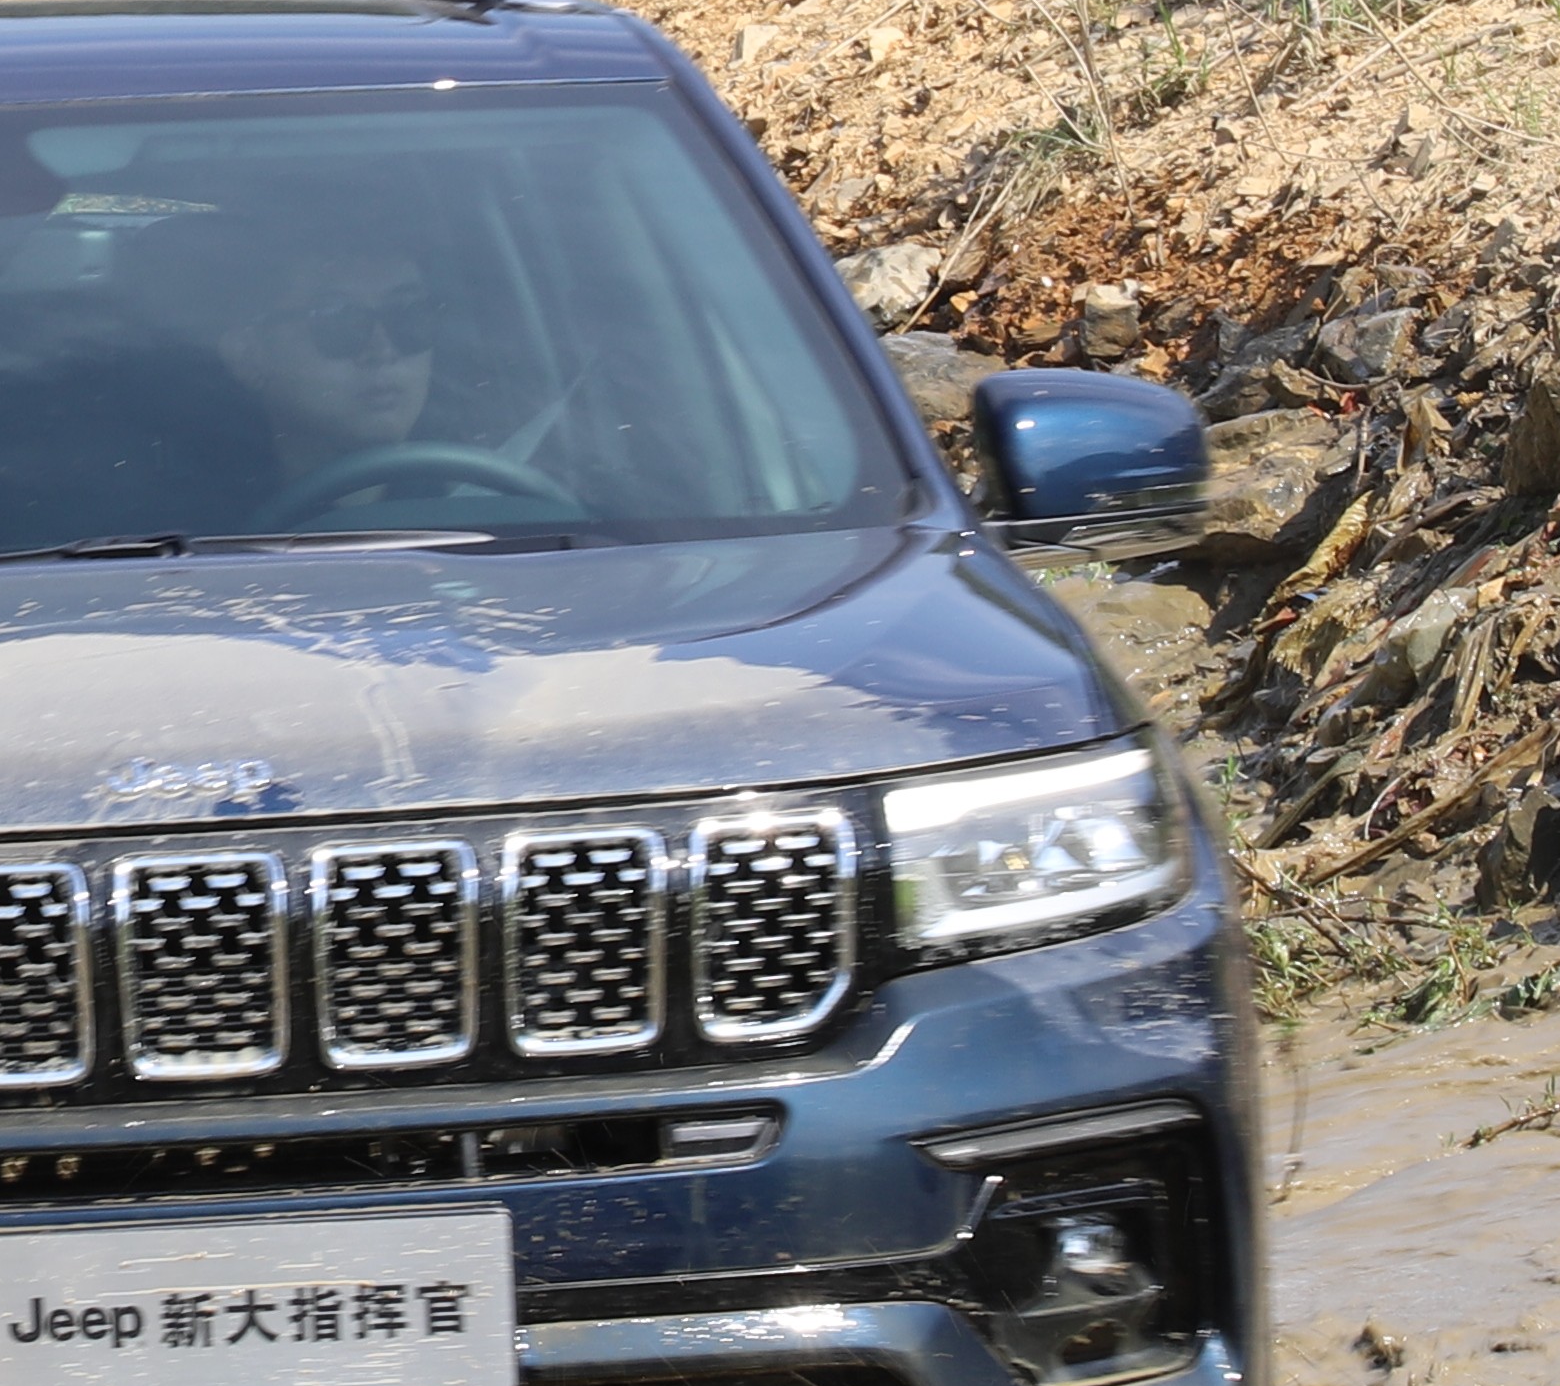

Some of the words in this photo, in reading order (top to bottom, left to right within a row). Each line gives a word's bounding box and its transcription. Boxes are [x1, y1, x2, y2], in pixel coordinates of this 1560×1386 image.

[9, 1295, 145, 1349] Jeep
[160, 1280, 472, 1349] 新大指挥官
